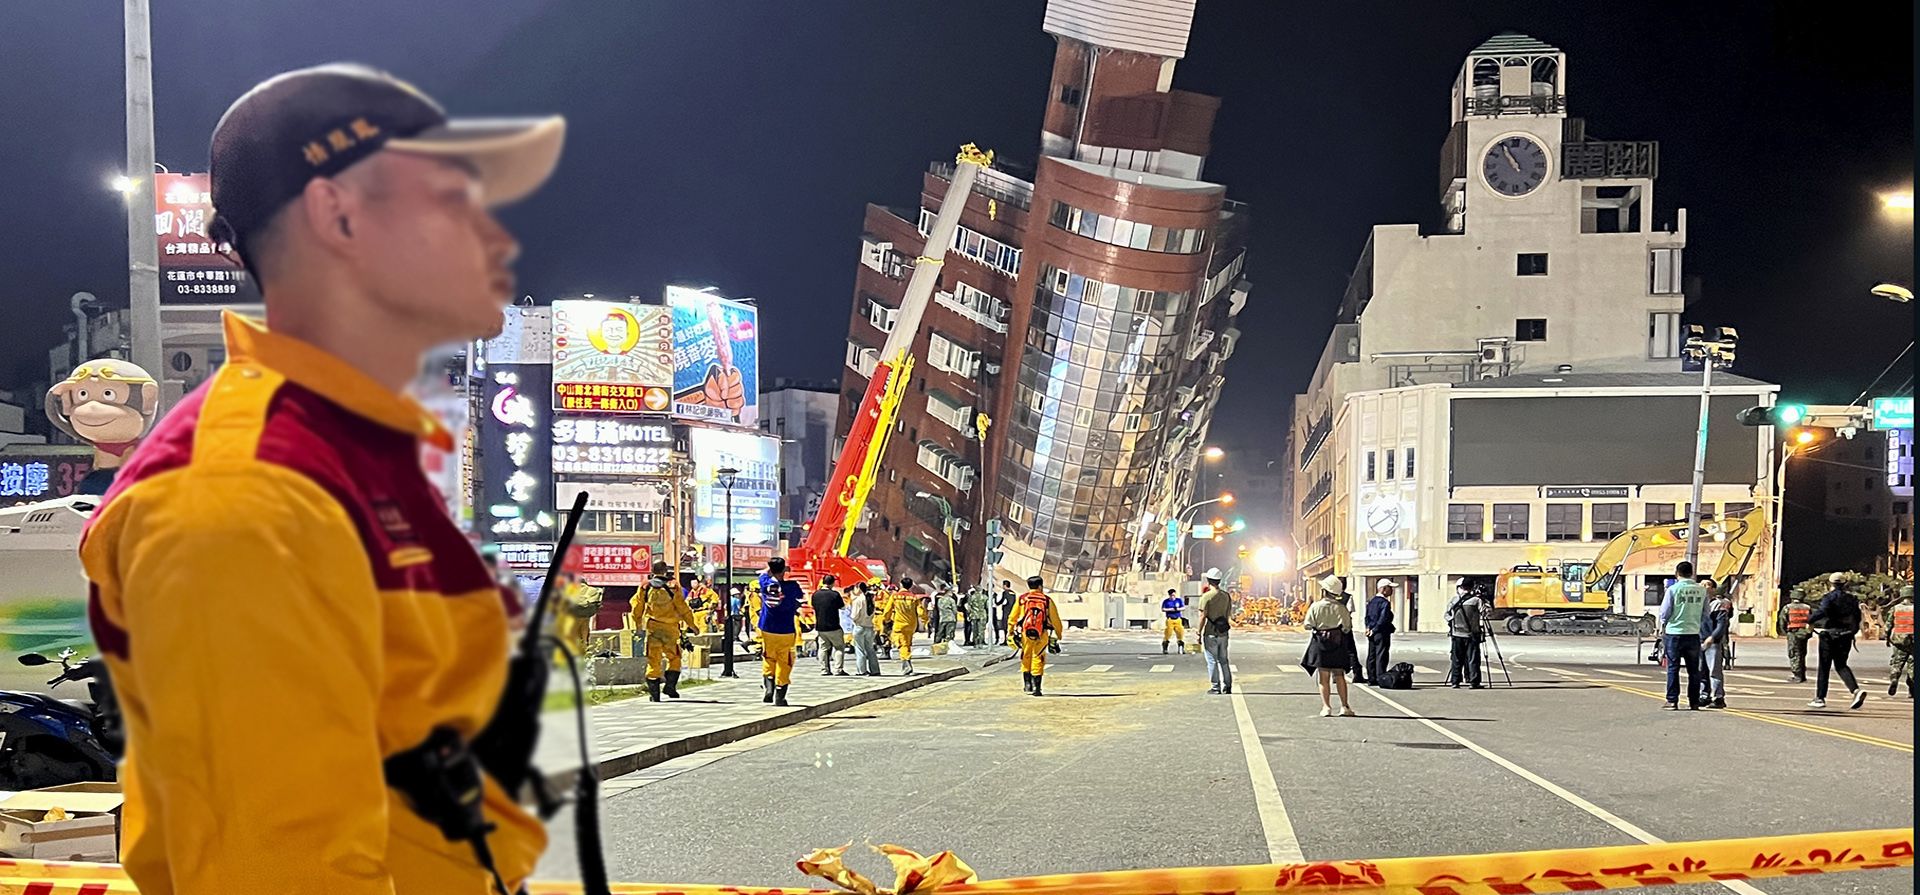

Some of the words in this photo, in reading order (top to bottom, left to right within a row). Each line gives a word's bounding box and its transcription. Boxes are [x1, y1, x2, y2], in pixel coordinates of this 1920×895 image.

[177, 285, 236, 294] 03-8338899
[552, 445, 671, 463] 03-8316622
[1, 462, 48, 496] 按摩
[1564, 582, 1582, 592] CAT
